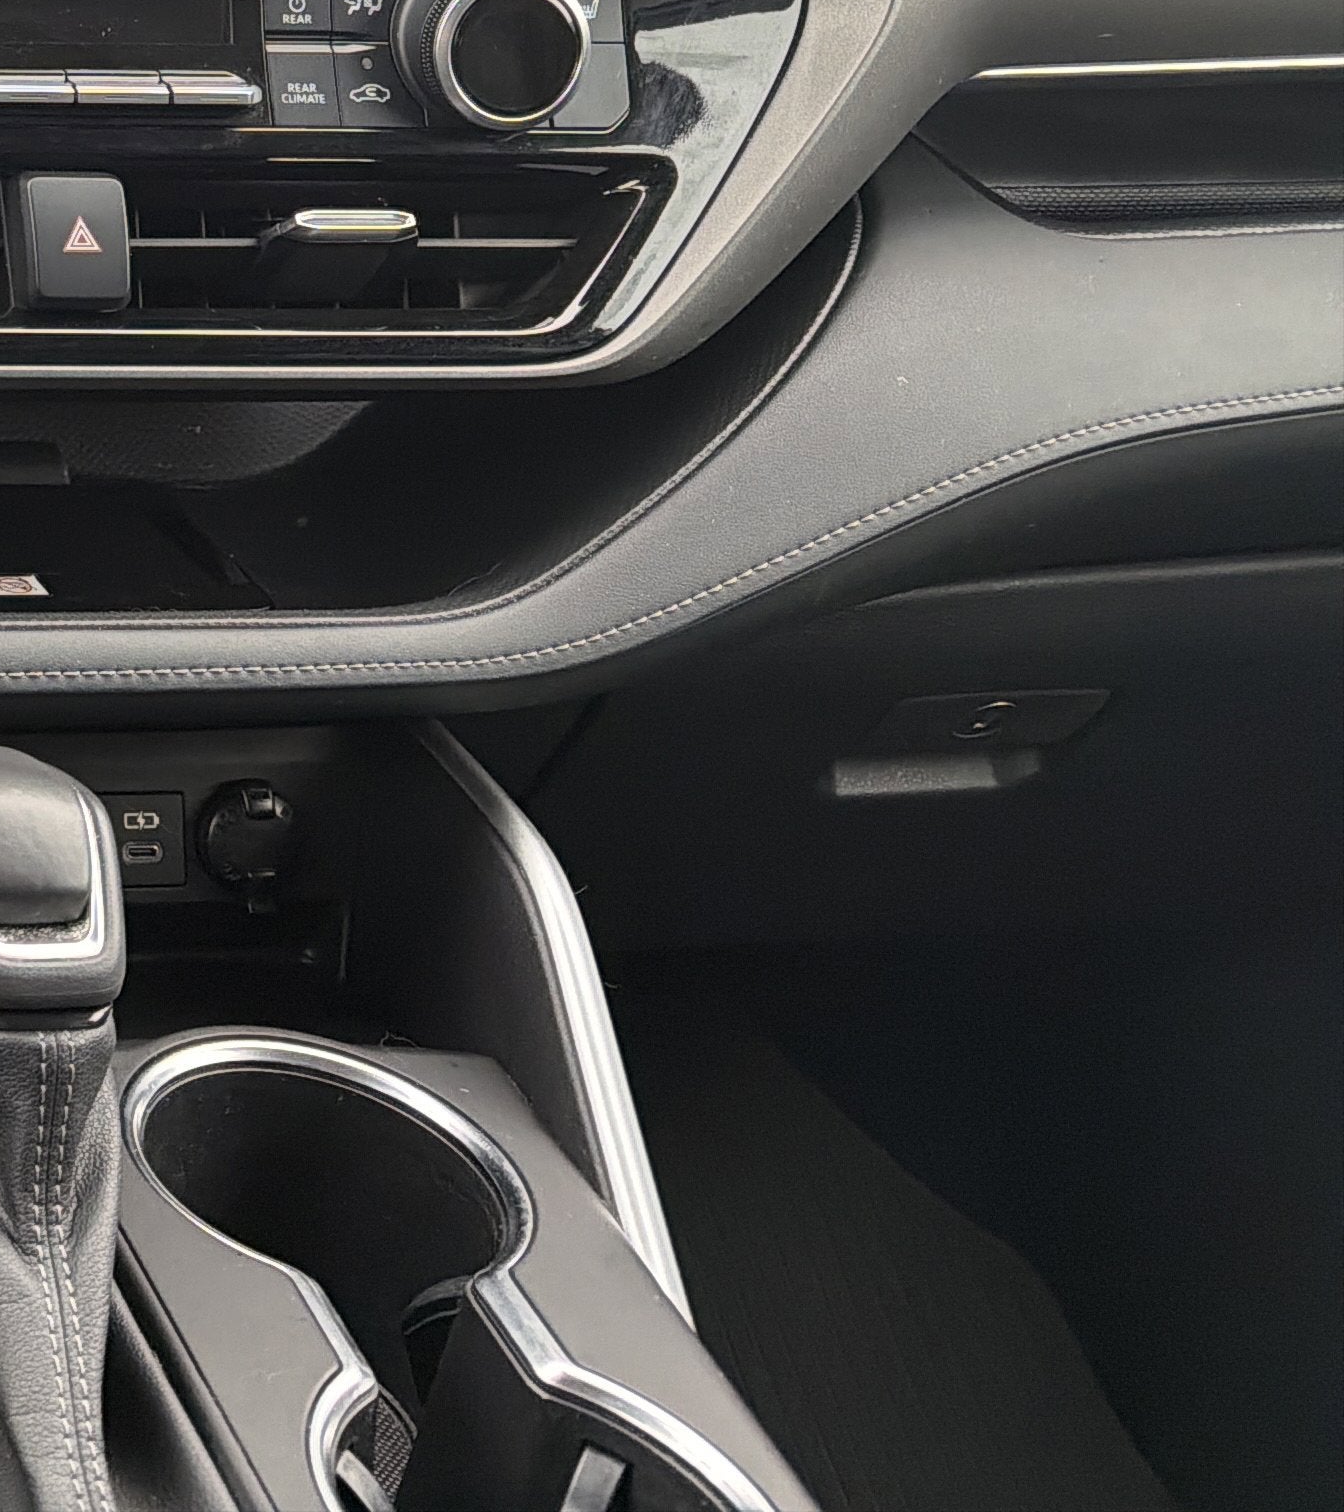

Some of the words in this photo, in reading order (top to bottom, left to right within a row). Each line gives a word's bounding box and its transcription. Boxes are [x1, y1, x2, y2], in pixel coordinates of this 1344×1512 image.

[282, 14, 313, 25] REAR
[287, 82, 318, 94] REAR
[281, 93, 327, 105] CLIMATE
